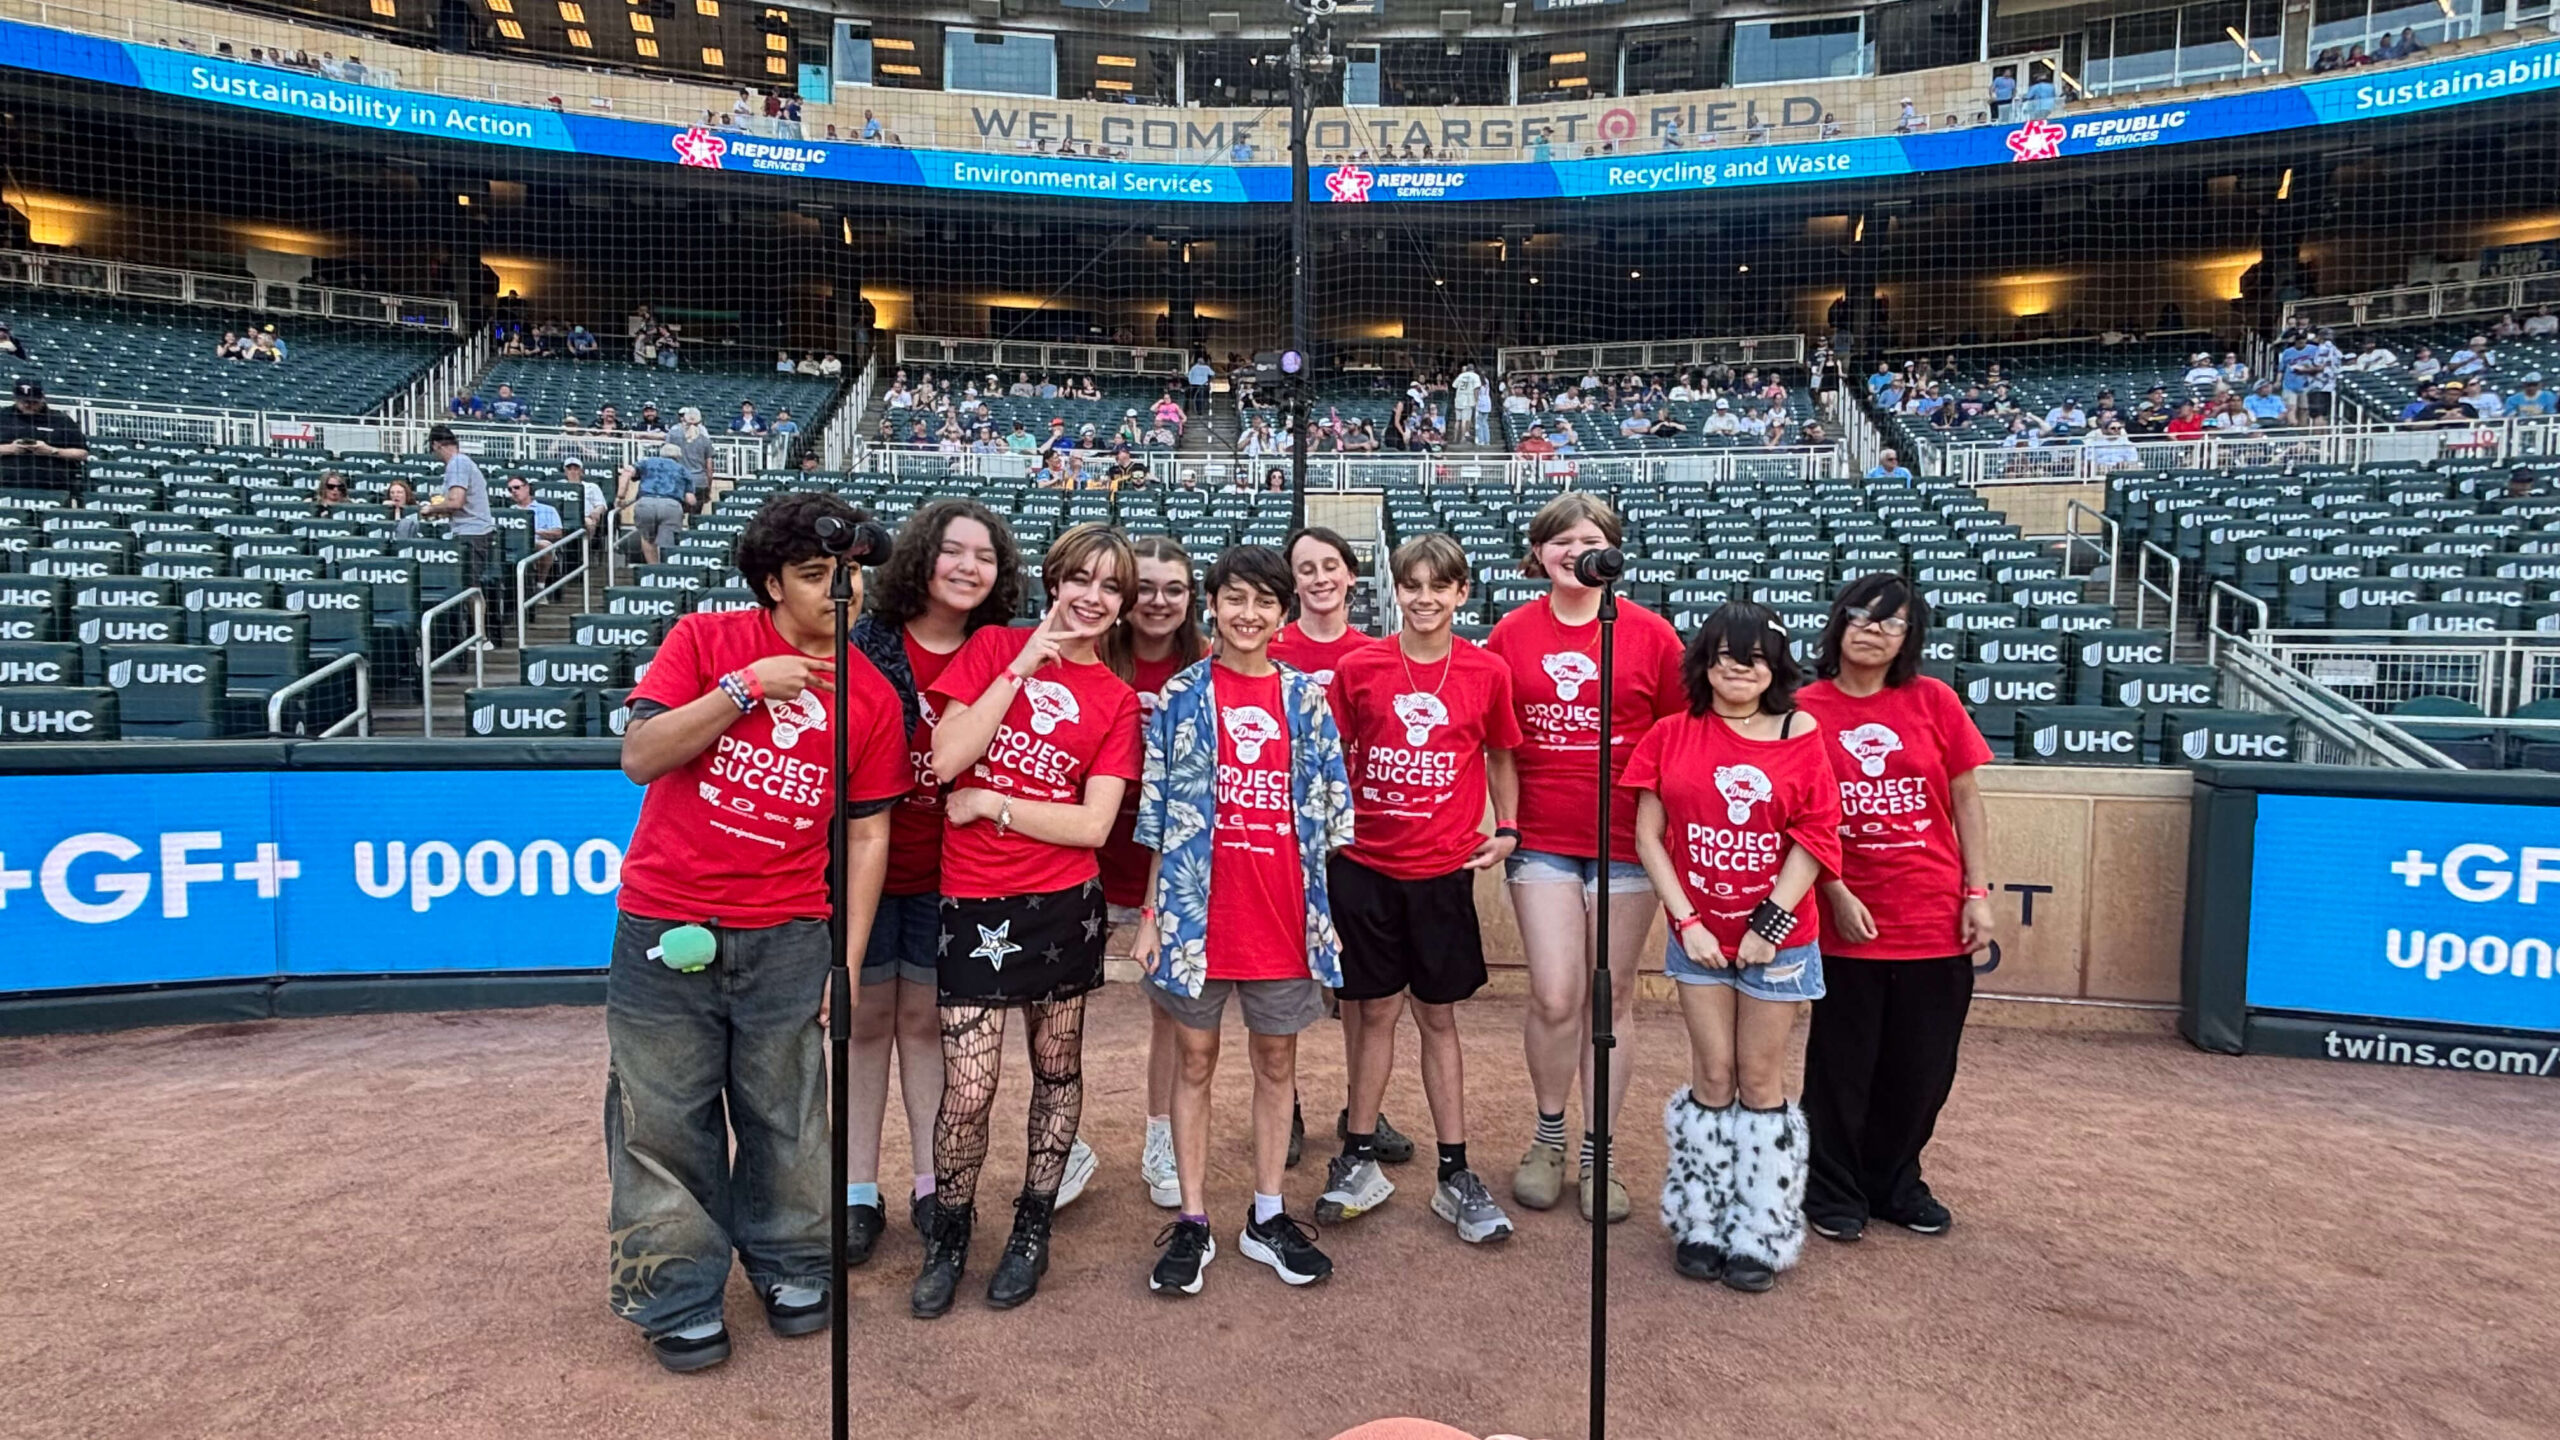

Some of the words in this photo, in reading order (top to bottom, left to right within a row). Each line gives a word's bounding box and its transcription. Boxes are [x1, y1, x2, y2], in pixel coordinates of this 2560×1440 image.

[191, 67, 402, 126] Sustainability
[411, 103, 436, 126] in
[445, 109, 533, 139] Action
[971, 107, 1260, 150] WELCOME
[1369, 113, 1588, 149] TARGET
[1651, 96, 1823, 137] FIELD
[2071, 111, 2187, 139] REPUBLIC
[2095, 130, 2159, 147] SERVICES
[731, 141, 827, 164] REPUBLIC
[752, 159, 806, 172] SERVICES
[1608, 162, 1717, 188] Recycling
[1723, 156, 1768, 178] and
[1776, 153, 1851, 174] Waste
[954, 162, 1116, 191] Environmental
[1123, 173, 1213, 194] Services
[1377, 173, 1465, 187] REPUBLIC
[1397, 187, 1445, 197] SERVICES
[546, 489, 578, 500] UHC
[985, 505, 1011, 514] HC
[491, 517, 526, 530] HC
[2228, 530, 2267, 541] UHC
[73, 541, 122, 552] UHC
[336, 549, 380, 560] UHC
[2265, 547, 2308, 560] UHC
[416, 550, 458, 563] UHC
[684, 557, 724, 569] UHC
[1193, 553, 1218, 563] HC
[1666, 552, 1700, 563] UHC
[1730, 552, 1765, 563] UHC
[51, 563, 108, 579] UHC
[160, 566, 216, 580] UHC
[265, 568, 314, 583] UHC
[361, 570, 408, 583] UHC
[1640, 570, 1675, 582] UHC
[1713, 570, 1750, 582] UHC
[1787, 570, 1824, 581] UHC
[1937, 570, 1976, 581] UHC
[2311, 567, 2359, 580] UHC
[2413, 566, 2464, 579] UHC
[658, 577, 699, 590] UHC
[99, 591, 161, 607] UHC
[205, 592, 264, 610] UHC
[308, 594, 360, 609] UHC
[1687, 591, 1727, 602] UHC
[1771, 591, 1812, 602] UHC
[1943, 592, 1986, 604] UHC
[2033, 591, 2077, 605] UHC
[2362, 591, 2418, 605] UHC
[2466, 591, 2522, 606] UHC
[629, 601, 674, 615] UHC
[1452, 612, 1479, 625] HC
[1782, 614, 1828, 630] UHC
[1967, 616, 2015, 629] UHC
[2063, 618, 2111, 631] UHC
[2432, 617, 2497, 634] UHC
[106, 623, 168, 640] UHC
[234, 624, 293, 642] UHC
[598, 629, 648, 645] UHC
[1923, 643, 1954, 659] HC
[2004, 644, 2057, 661] UHC
[2107, 646, 2162, 662] UHC
[137, 664, 206, 683] UHC
[552, 664, 608, 681] UHC
[1995, 682, 2056, 700] UHC
[2148, 684, 2210, 703] UHC
[501, 709, 566, 729] UHC
[1524, 704, 1600, 721] PROJEC
[11, 710, 93, 732] UHC
[995, 724, 1080, 773] ROJECT
[2065, 731, 2134, 752] UHC
[2215, 734, 2287, 756] UHC
[717, 735, 829, 786] PROJECT
[988, 742, 1068, 787] UCCESS
[1368, 746, 1456, 769] PROJECT
[709, 756, 823, 807] SUCCESS
[1217, 765, 1290, 791] ROJECT
[1366, 763, 1456, 787] SUCCESS
[1840, 777, 1926, 799] ROJECT
[1217, 786, 1290, 810] UCCESS
[1842, 794, 1926, 816] UCCESS
[1687, 823, 1781, 851] PROJECT
[353, 838, 622, 913] upono
[2386, 928, 2560, 981] upon
[2325, 1030, 2560, 1076] twins.com/
